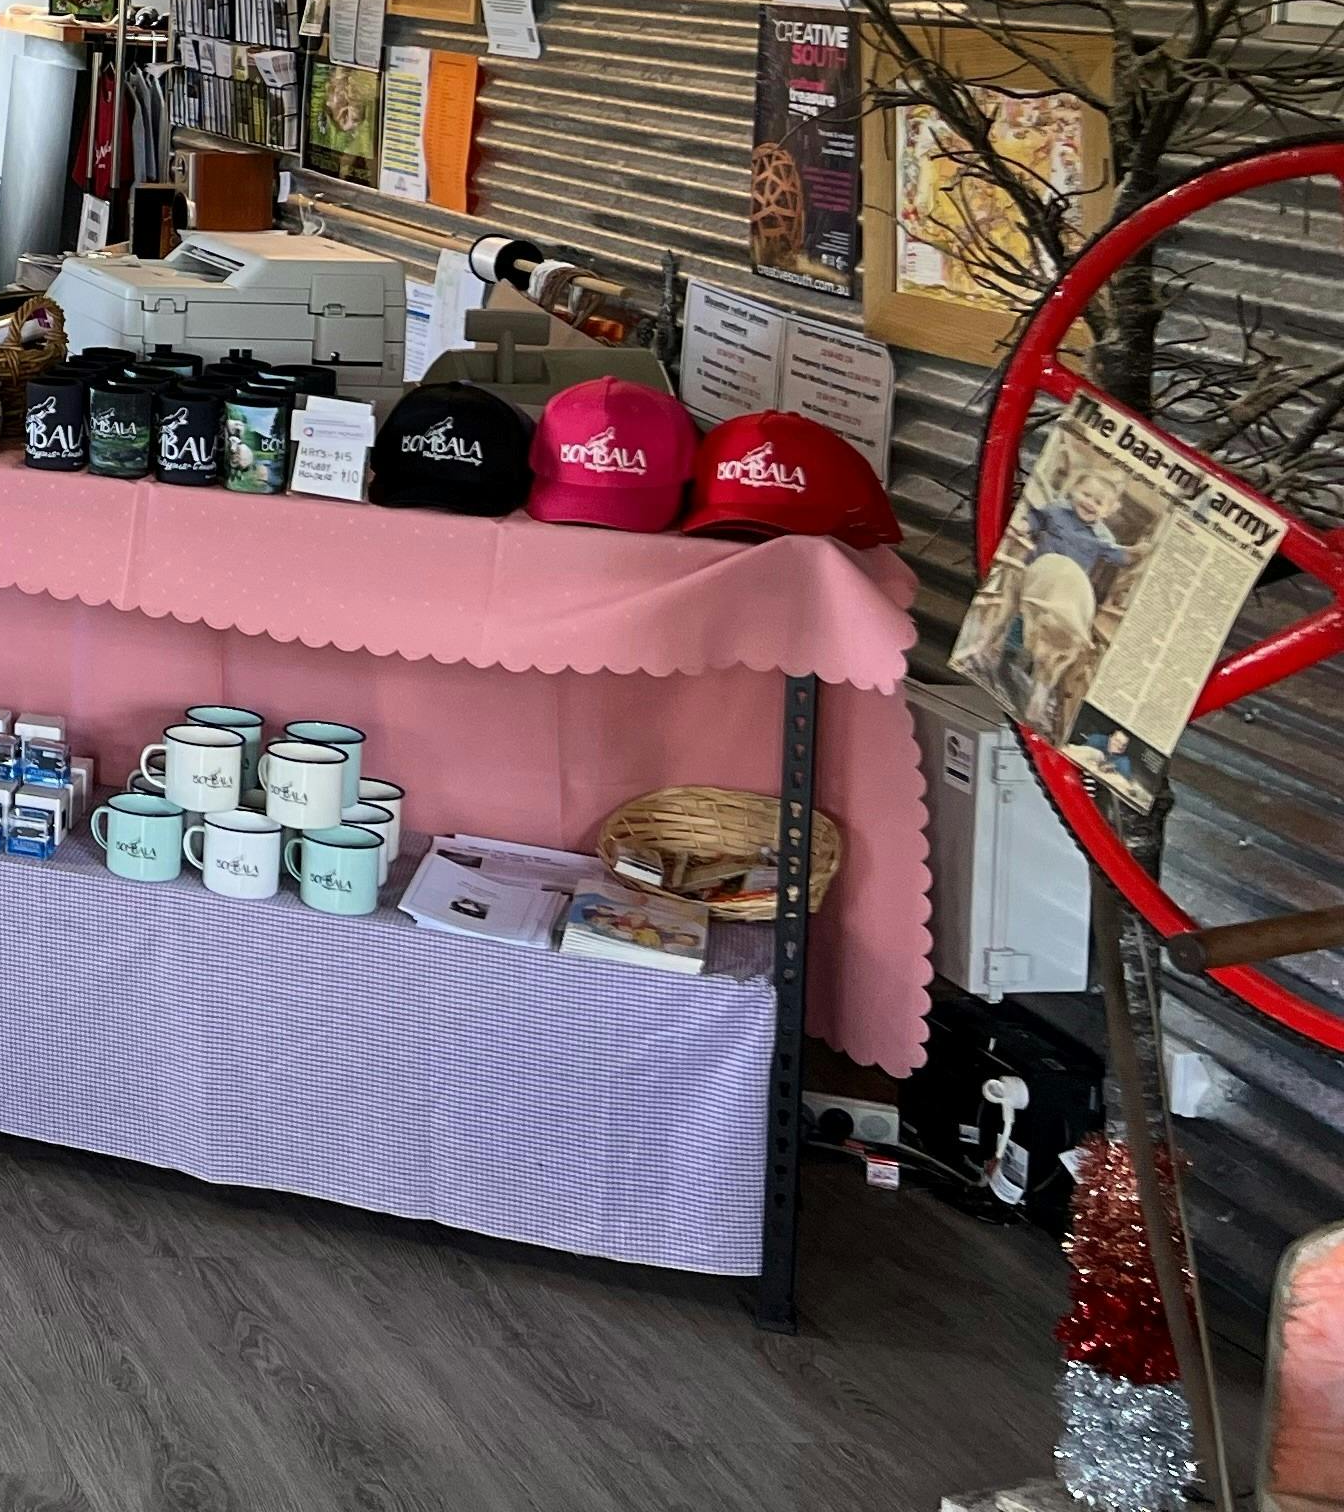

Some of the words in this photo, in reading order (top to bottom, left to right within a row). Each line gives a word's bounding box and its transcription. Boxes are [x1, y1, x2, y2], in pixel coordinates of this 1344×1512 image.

[775, 21, 849, 48] CREATIVE
[791, 44, 848, 69] SOUTH
[757, 265, 850, 296] creativesouth.com.au
[401, 435, 483, 459] BOMBALA
[560, 443, 647, 468] BOMBALA
[717, 460, 805, 485] BOMBALA
[1074, 394, 1117, 438] The
[1116, 424, 1210, 501] baa-my
[1210, 491, 1280, 547] army
